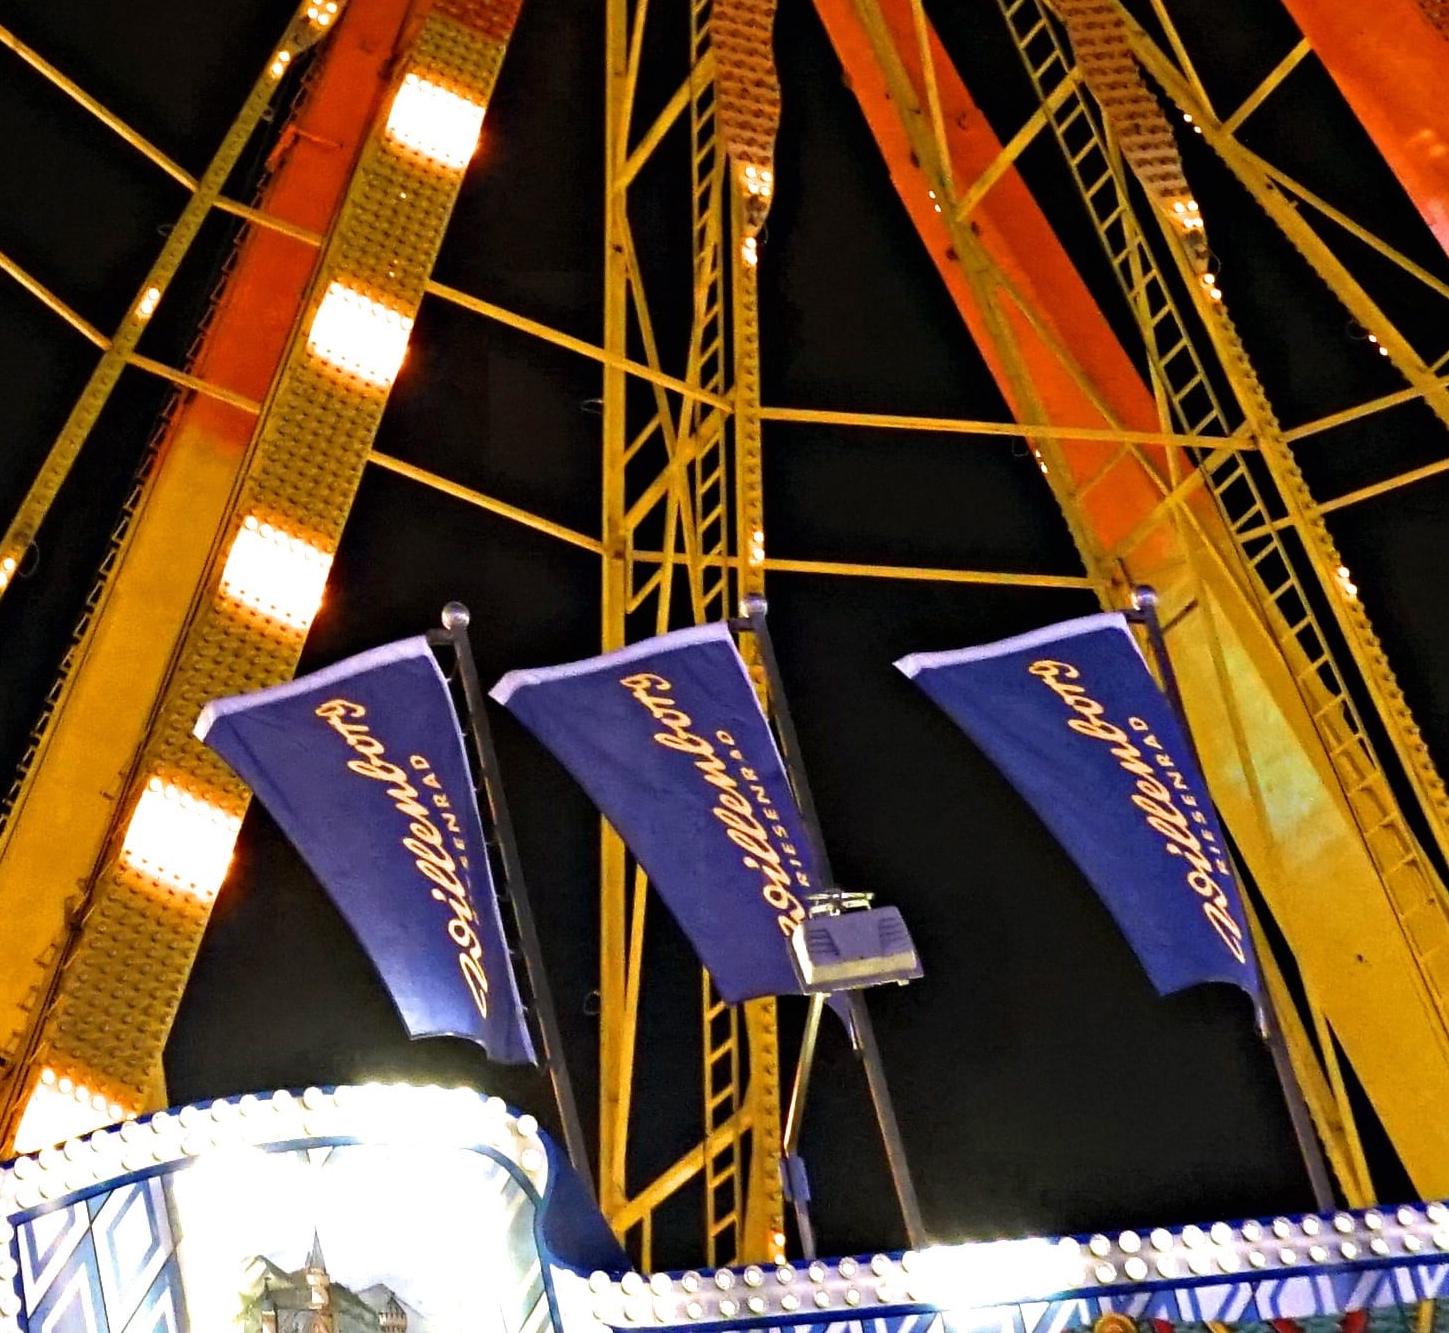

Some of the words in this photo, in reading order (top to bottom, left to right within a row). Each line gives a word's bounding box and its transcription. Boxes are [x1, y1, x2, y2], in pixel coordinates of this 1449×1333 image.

[314, 698, 489, 1017] Willenborg
[715, 730, 810, 887] RIESENRAD
[1028, 659, 1245, 964] Willenborg
[1128, 716, 1230, 875] RIESENRAD
